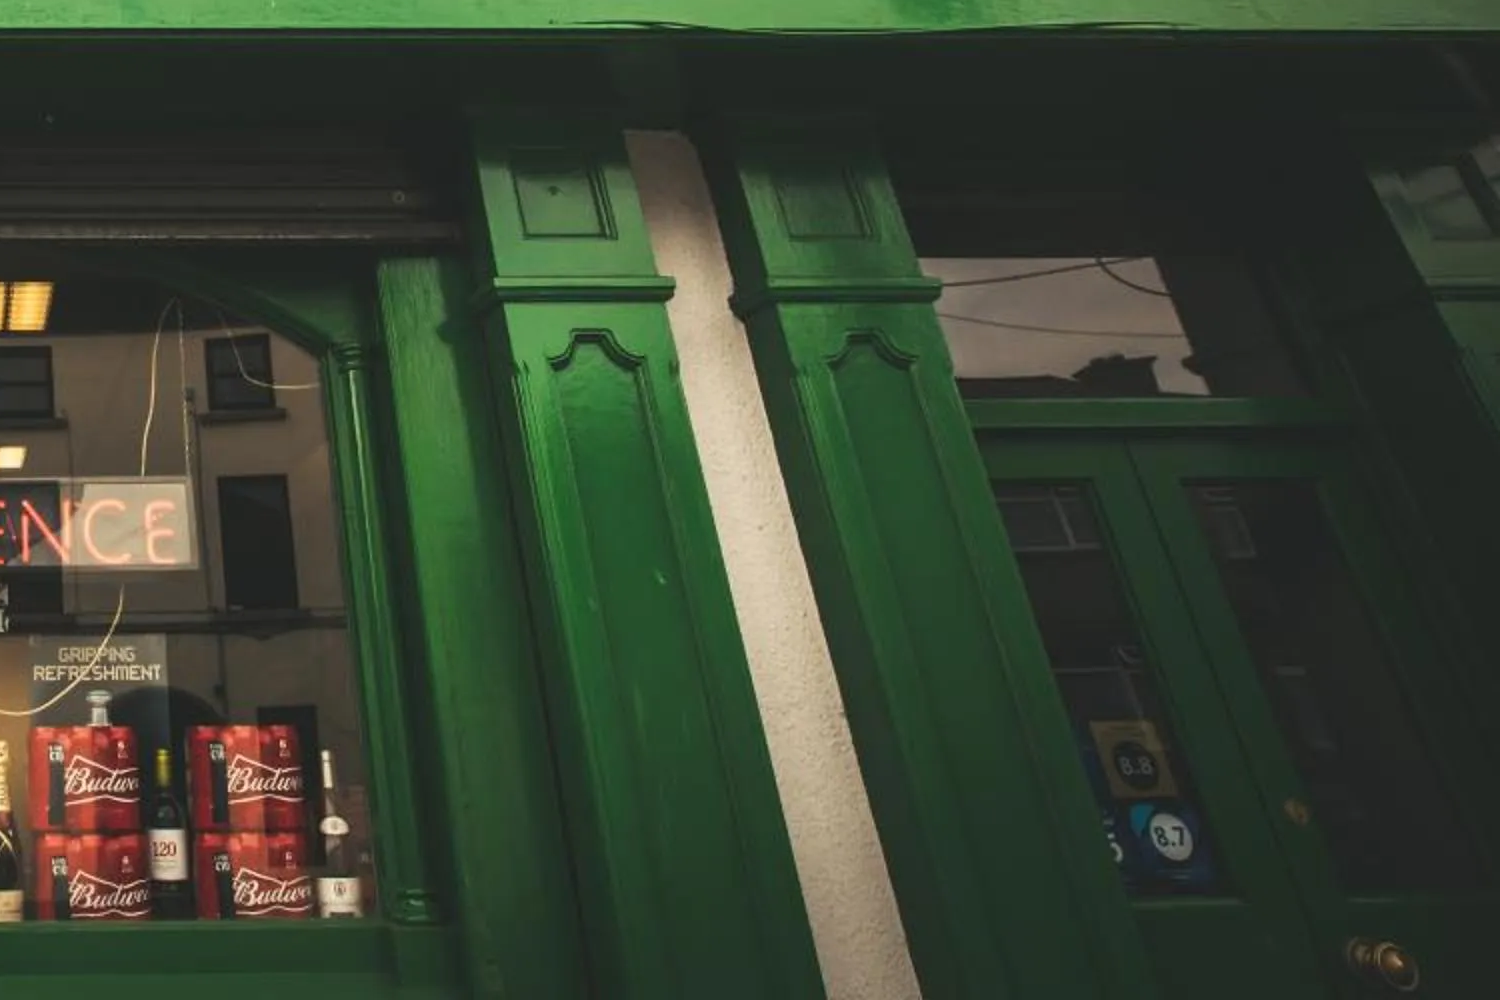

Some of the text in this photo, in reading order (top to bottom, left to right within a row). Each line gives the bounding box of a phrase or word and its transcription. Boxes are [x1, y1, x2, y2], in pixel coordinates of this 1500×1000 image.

[57, 647, 136, 662] GRIPPING
[33, 664, 161, 680] REFRESHMENT
[1119, 755, 1154, 777] 8.8
[1153, 825, 1186, 848] 8.7
[152, 841, 178, 857] 120
